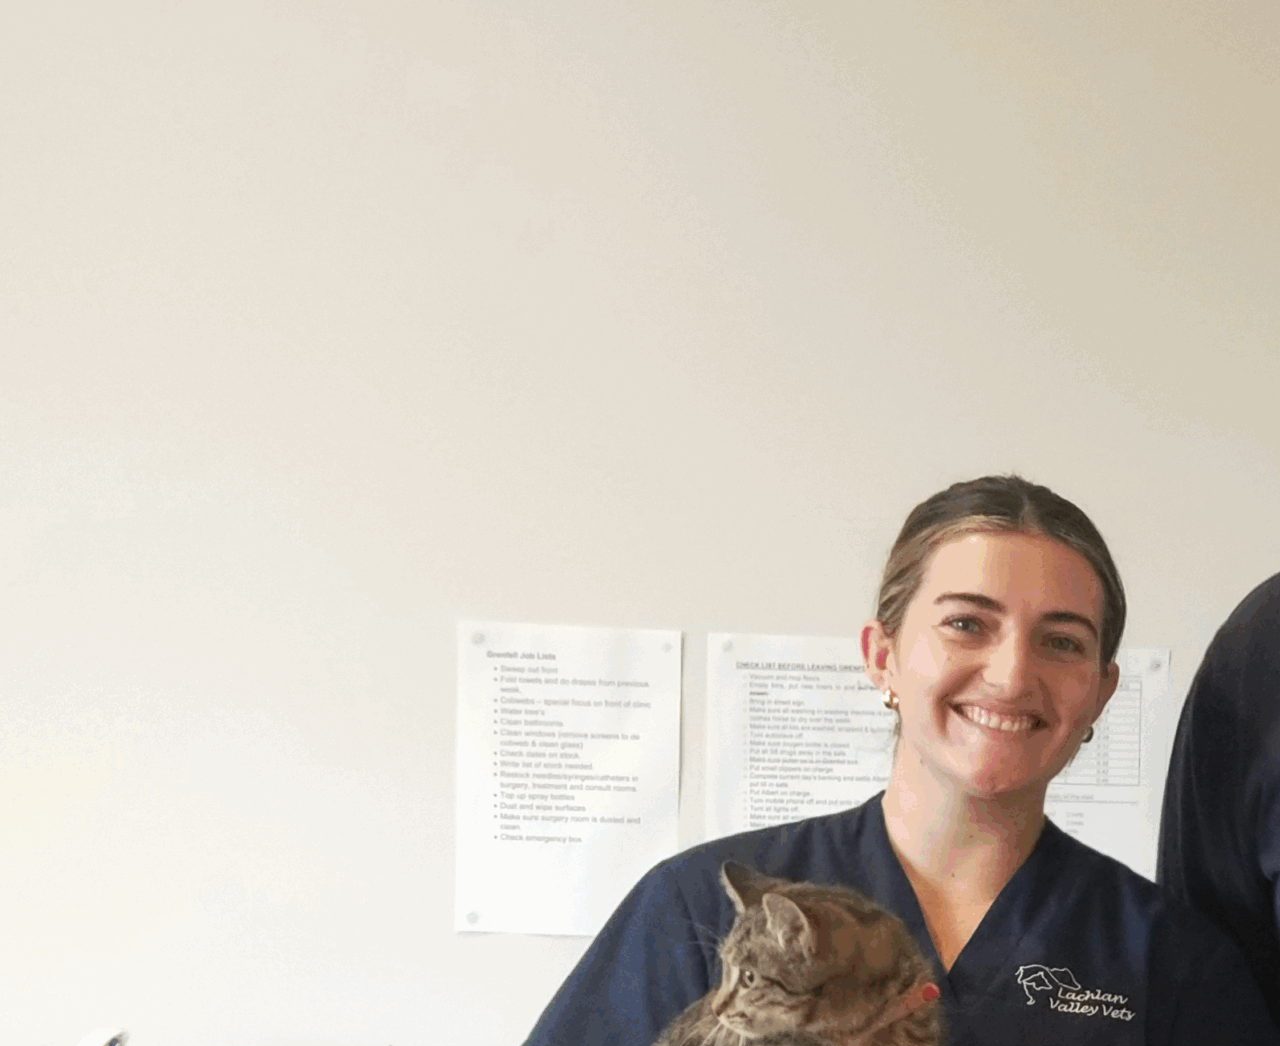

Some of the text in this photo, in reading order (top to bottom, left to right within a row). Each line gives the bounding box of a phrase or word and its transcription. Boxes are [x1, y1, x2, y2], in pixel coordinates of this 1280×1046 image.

[761, 662, 775, 670] LIST
[544, 698, 570, 706] special
[623, 700, 631, 708] of
[558, 731, 588, 739] (remove
[560, 741, 583, 749] glass)
[780, 749, 796, 757] drugs
[500, 833, 566, 843] Check emergency
[1058, 987, 1128, 1004] Lachlan
[1049, 997, 1136, 1021] Valley Vets
